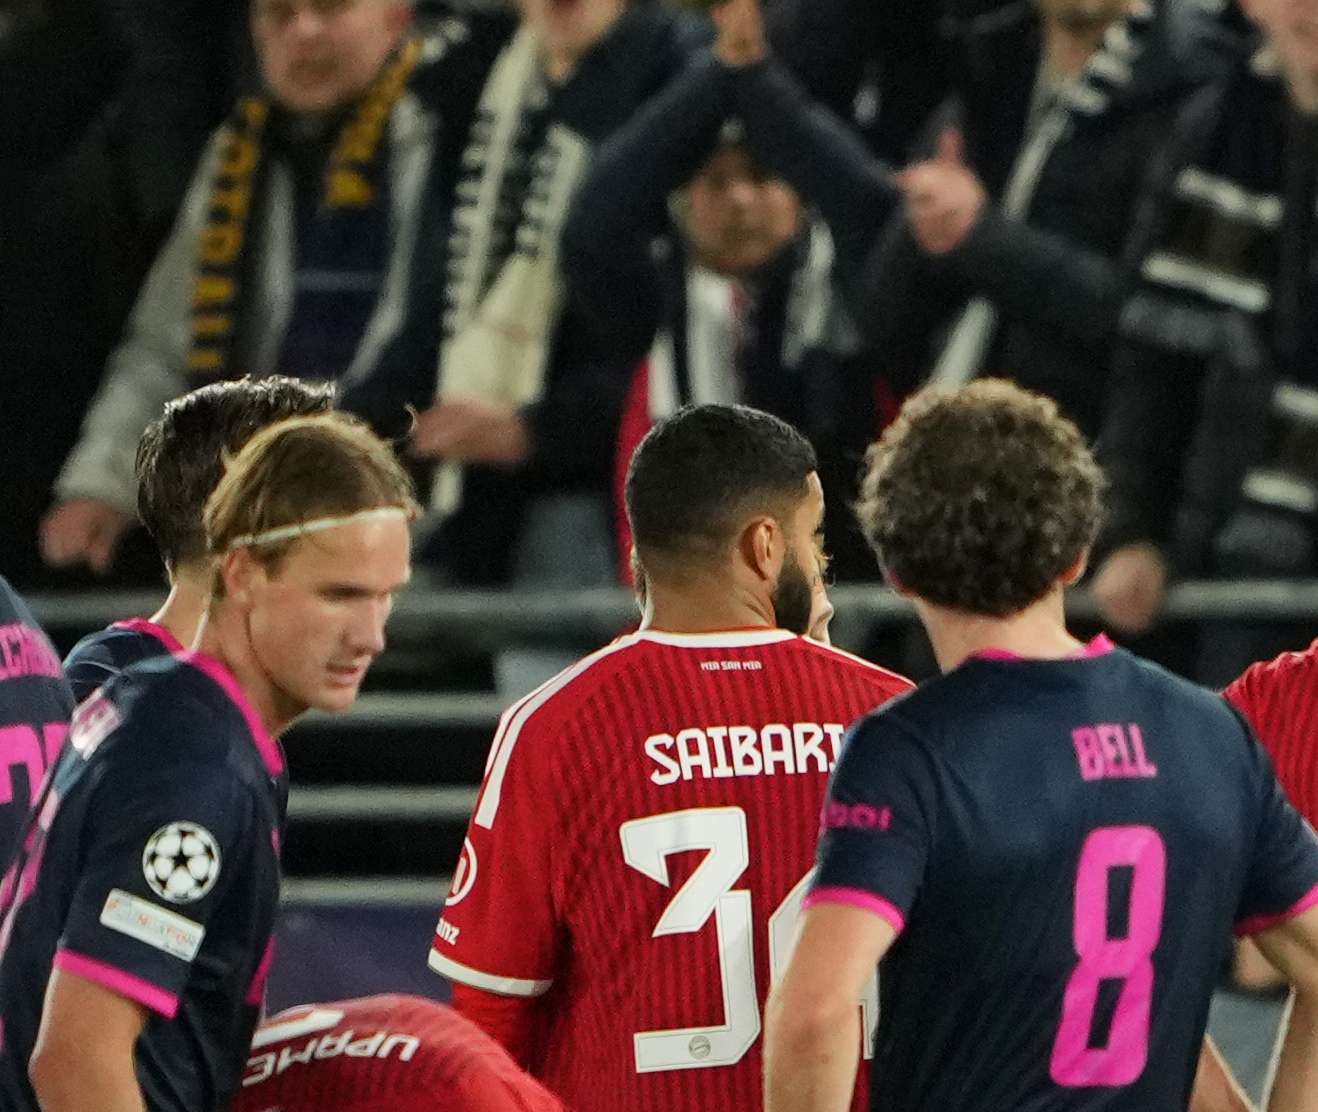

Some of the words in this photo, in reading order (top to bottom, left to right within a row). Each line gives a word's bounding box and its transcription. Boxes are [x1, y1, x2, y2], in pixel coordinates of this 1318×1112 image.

[644, 723, 846, 786] SAIBARI
[1071, 722, 1158, 782] BELL
[1049, 823, 1167, 1087] 8
